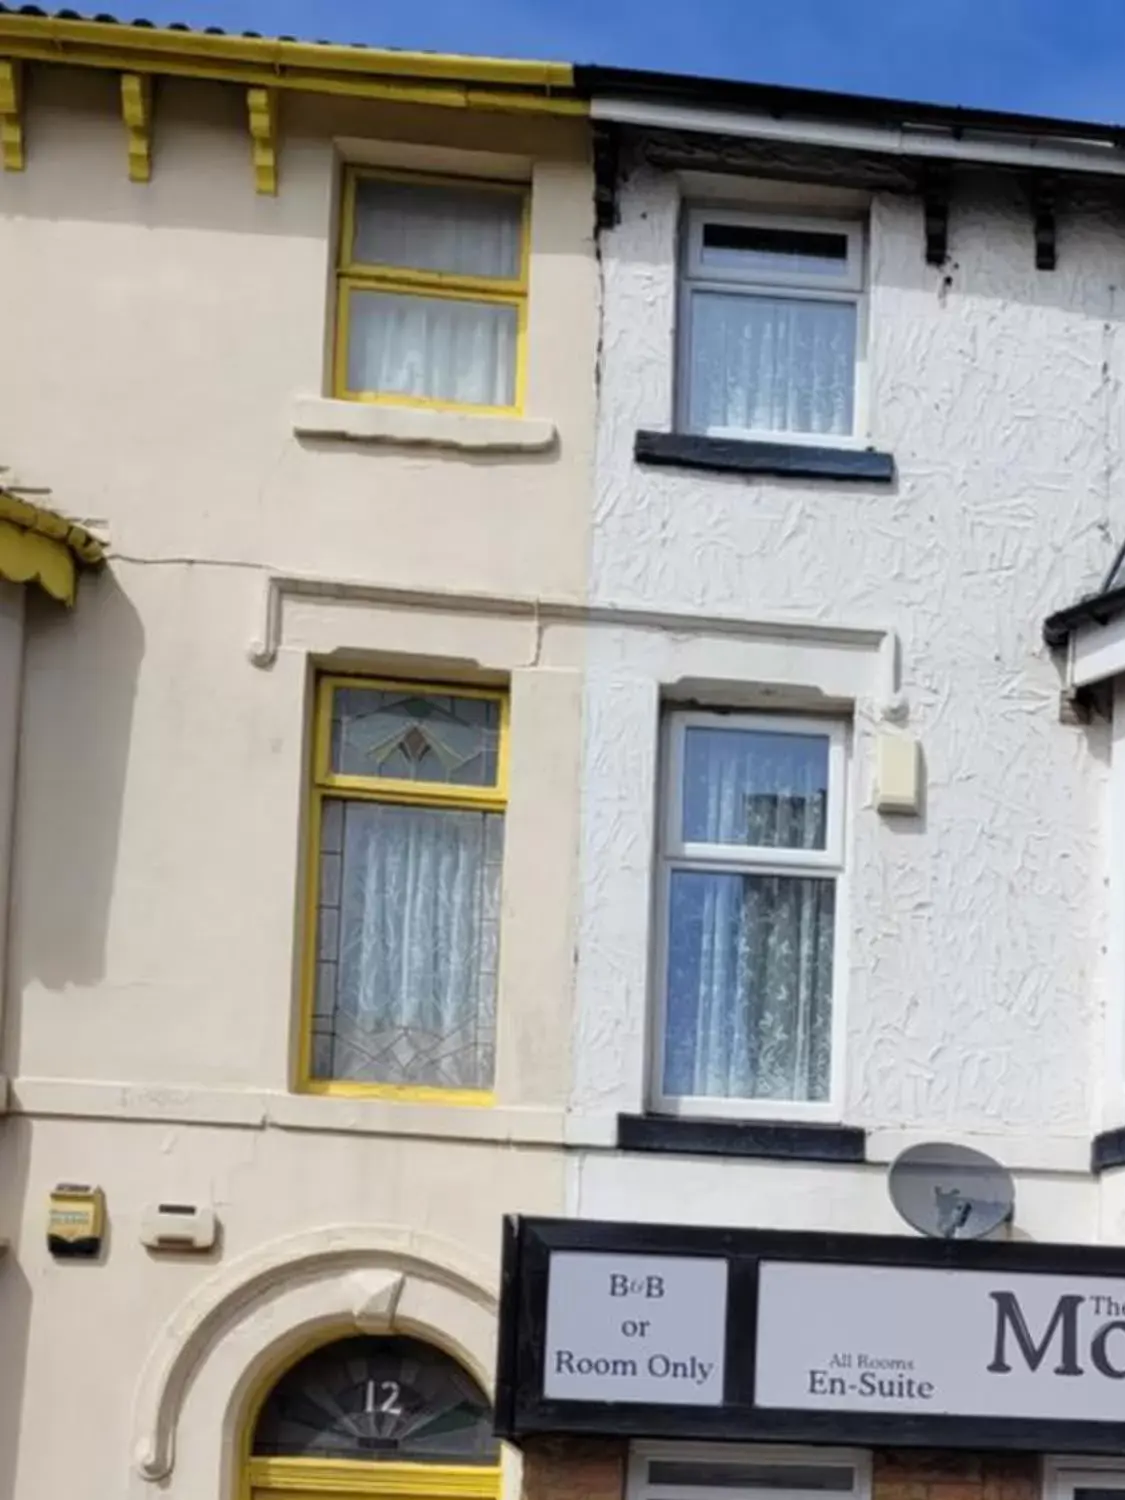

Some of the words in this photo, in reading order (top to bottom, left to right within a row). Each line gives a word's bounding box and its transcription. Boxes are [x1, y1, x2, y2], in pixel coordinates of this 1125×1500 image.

[609, 1273, 665, 1299] B&B
[621, 1320, 651, 1337] or
[555, 1350, 637, 1376] Room
[648, 1354, 714, 1385] Only
[829, 1352, 851, 1368] All
[857, 1354, 914, 1371] Rooms
[366, 1380, 402, 1416] 12
[808, 1369, 934, 1399] En-Suite
